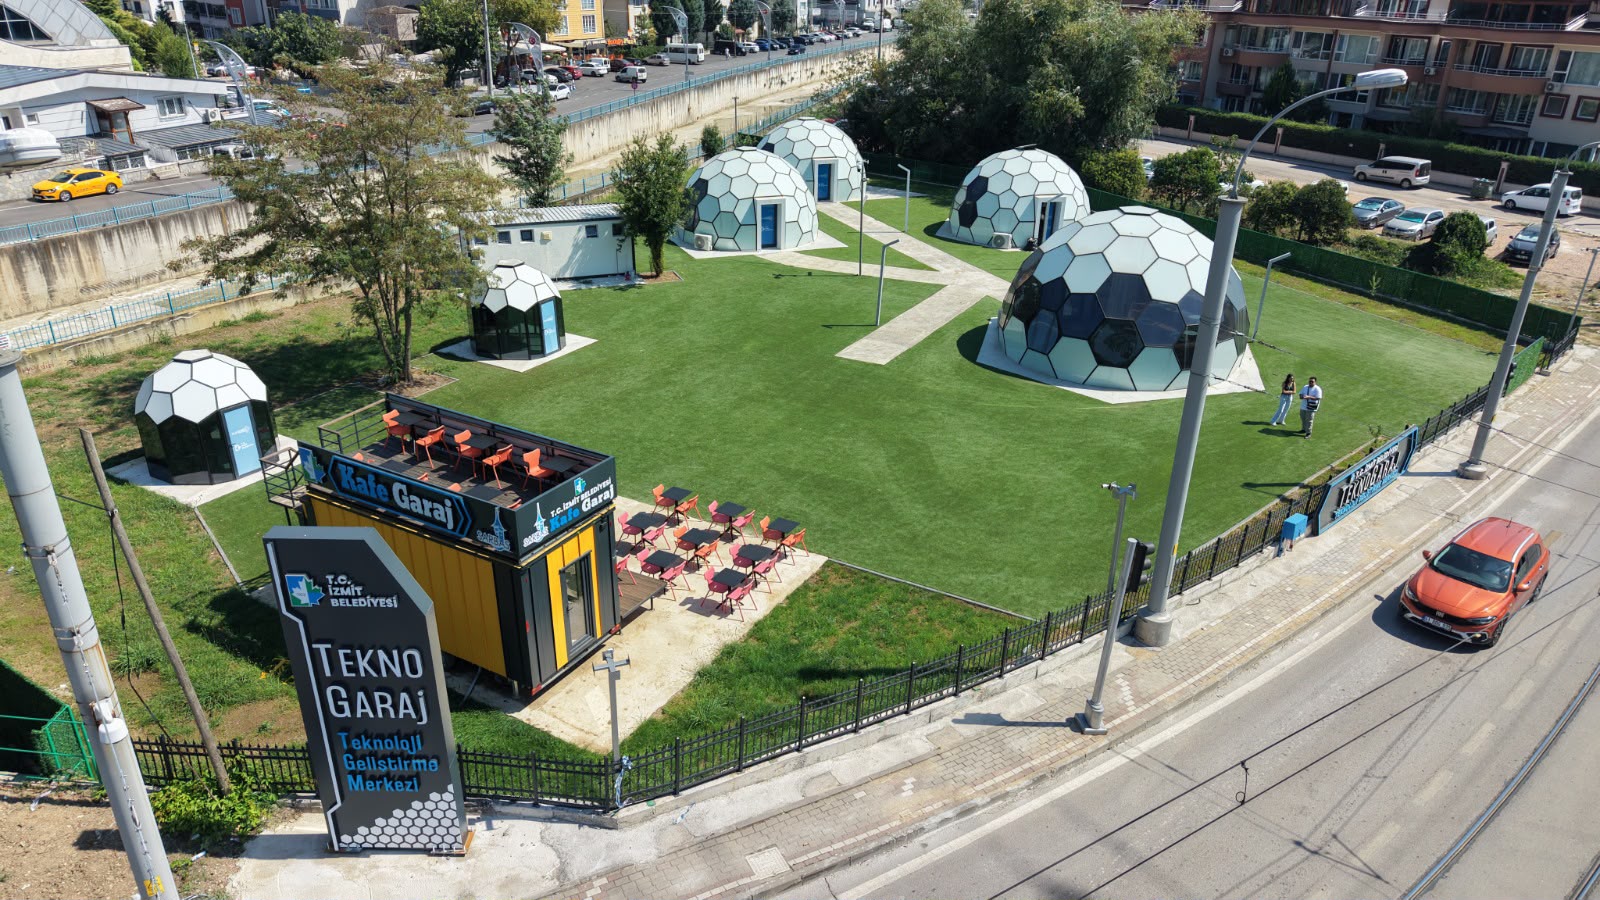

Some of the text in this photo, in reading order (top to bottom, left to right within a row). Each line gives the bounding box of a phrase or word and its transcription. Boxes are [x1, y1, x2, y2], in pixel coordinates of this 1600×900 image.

[337, 463, 454, 530] Kafe Garaj
[549, 484, 615, 532] Kafe Garaj
[326, 574, 351, 585] T.C.
[328, 583, 363, 596] İZMİT
[330, 594, 398, 608] BELEDİYESİ
[311, 643, 423, 679] TEKNO
[337, 731, 422, 755] Teknoloji
[342, 753, 439, 772] Geliştirme
[347, 774, 419, 792] Merkezi
